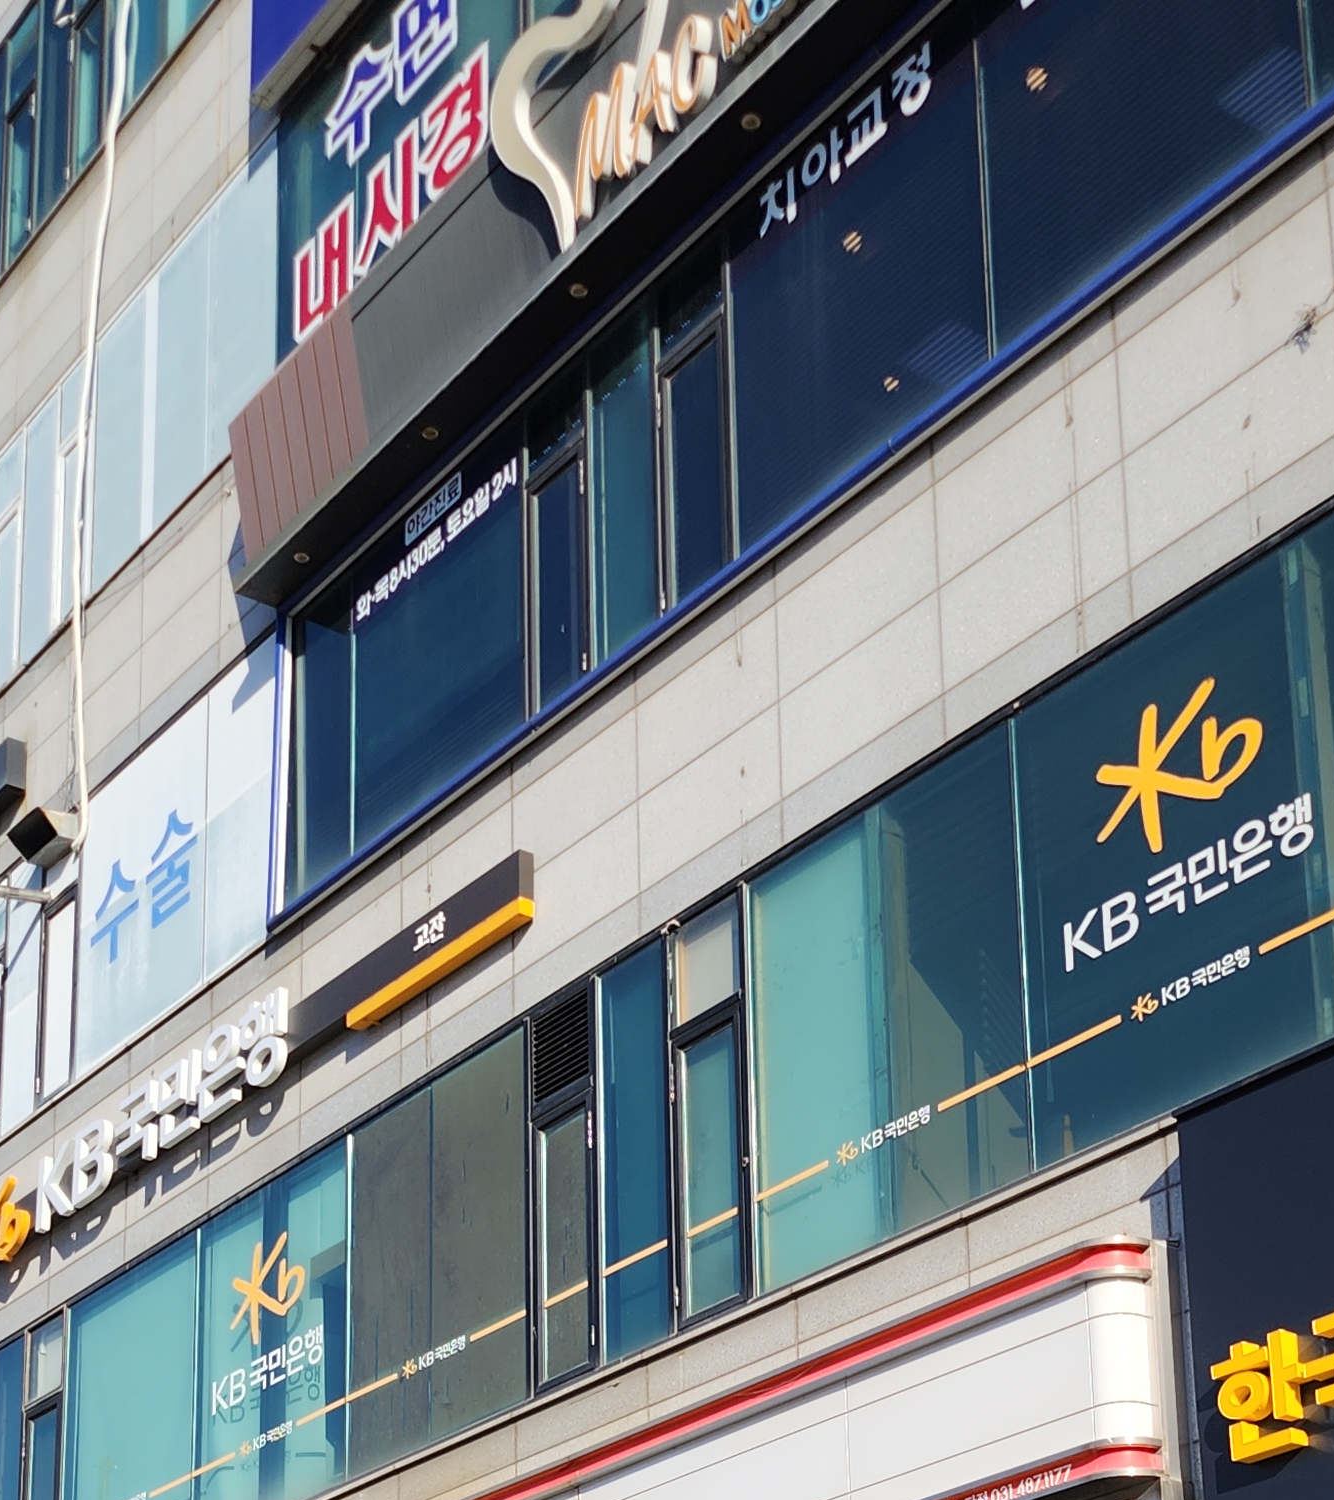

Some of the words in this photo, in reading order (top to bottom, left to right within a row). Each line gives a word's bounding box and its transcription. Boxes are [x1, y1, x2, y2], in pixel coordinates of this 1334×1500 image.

[326, 0, 457, 167] 수면
[294, 40, 489, 343] 내시경
[407, 474, 461, 536] 야간진료
[447, 482, 490, 542] 토요일
[492, 457, 517, 501] 2시
[91, 809, 195, 964] 수술
[412, 910, 447, 952] 고잔
